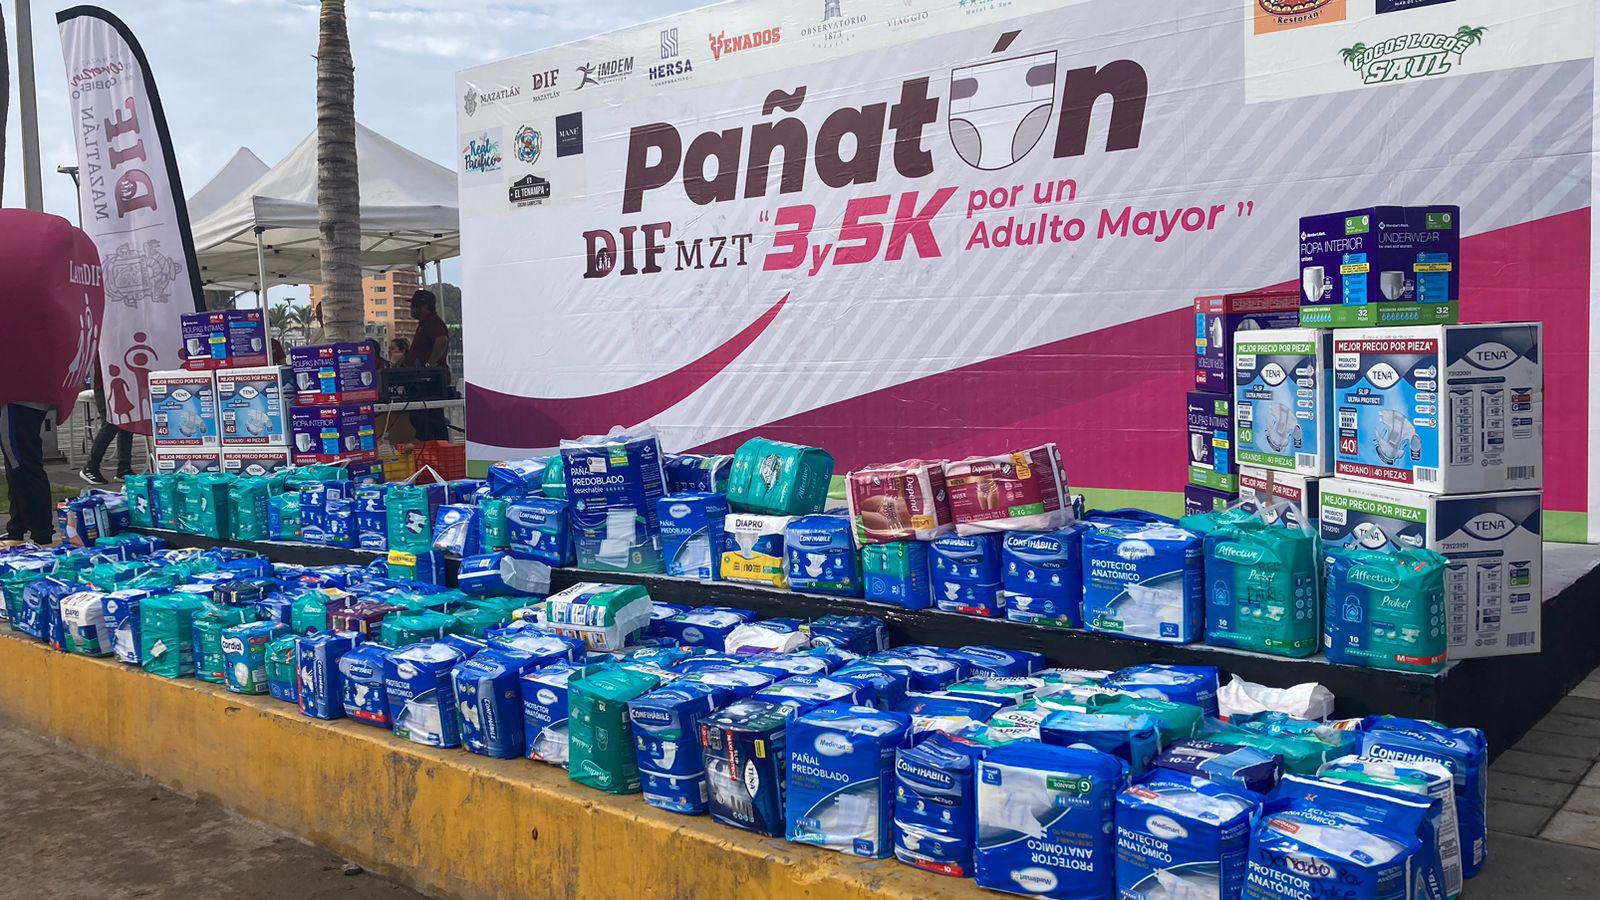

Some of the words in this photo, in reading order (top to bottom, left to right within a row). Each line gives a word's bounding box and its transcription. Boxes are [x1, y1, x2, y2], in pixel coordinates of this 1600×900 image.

[801, 14, 867, 37] OBSERVATORIO
[887, 11, 929, 27] VIAGGIO
[824, 31, 842, 41] 1873
[709, 27, 781, 61] VENADOS
[1353, 35, 1409, 71] COCOS
[1409, 33, 1472, 55] LOCOS
[598, 57, 634, 76] IMDEM
[649, 59, 693, 80] HERSA
[1364, 51, 1451, 84] SAUL
[532, 68, 560, 90] DIF
[480, 86, 520, 103] MAZATLÁN
[470, 139, 491, 157] Real
[515, 189, 521, 198] EL
[521, 186, 545, 198] TENAMPA
[966, 184, 1024, 219] por
[1033, 178, 1077, 204] un
[1428, 214, 1434, 222] L
[965, 213, 1086, 250] Adulto
[1097, 203, 1225, 243] Mayor
[1378, 232, 1440, 243] UNDERWEAR
[582, 221, 671, 279] DIF
[675, 233, 752, 271] MZT
[1301, 242, 1323, 255] ROPA
[1325, 237, 1363, 252] INTERIOR
[1358, 309, 1368, 317] 32
[1238, 344, 1257, 353] MEJOR
[1258, 344, 1279, 353] PRECIO
[1280, 344, 1291, 352] POR
[1338, 341, 1361, 351] MEJOR
[1362, 340, 1388, 351] PRECIO
[1390, 340, 1406, 350] POR
[1476, 350, 1508, 361] TENA
[1265, 369, 1281, 379] TENA
[1373, 370, 1392, 380] TENA
[1361, 396, 1380, 404] PROTECT
[225, 425, 235, 433] 40
[308, 419, 334, 427] INTERIOR
[158, 427, 168, 435] 40
[1240, 430, 1251, 441] 40
[1341, 439, 1355, 452] 40
[1241, 453, 1261, 462] GRANDE
[1267, 456, 1273, 464] 40
[1274, 457, 1293, 467] PIEZAS
[971, 464, 995, 474] Depend
[1340, 463, 1369, 475] MEDIANO
[1374, 469, 1383, 477] 40
[1384, 470, 1407, 480] PIEZAS
[572, 475, 625, 486] PREDOBLADO
[1241, 477, 1257, 488] MEJOR
[1273, 483, 1282, 493] POR
[573, 486, 603, 494] desechable
[905, 476, 920, 512] Depend
[1324, 495, 1348, 507] MEJOR
[1349, 498, 1375, 510] PRECIO
[1377, 503, 1393, 514] POR
[1324, 509, 1344, 517] PRODUCTO
[735, 519, 763, 528] DIAPRO
[1474, 520, 1506, 530] TENA
[661, 527, 692, 535] PREDOBLADO
[1219, 545, 1259, 559] Affective
[1091, 559, 1137, 572] PROTECTOR
[1091, 567, 1140, 582] ANATÓMICO
[1350, 569, 1396, 584] Affective
[1381, 595, 1411, 610] Protect
[1092, 618, 1099, 627] G
[1219, 618, 1228, 626] 10
[222, 640, 243, 650] cordial
[1349, 635, 1359, 643] 10
[1396, 654, 1406, 662] M
[385, 679, 410, 689] PROTECTOR
[523, 700, 550, 714] PROTECTOR
[525, 708, 552, 722] ANATÓMICO
[791, 752, 820, 766] PAÑAL
[1169, 756, 1182, 764] 10
[747, 767, 756, 790] TENA
[791, 763, 850, 783] PREDOBLADO
[1082, 781, 1090, 792] G
[1118, 826, 1169, 852] PROTECTOR
[1027, 840, 1093, 859] ANATÓMICO
[1117, 838, 1172, 863] ANATÓMICO
[1031, 852, 1094, 872] PROTECTOR
[1248, 860, 1310, 891] PROTECTOR
